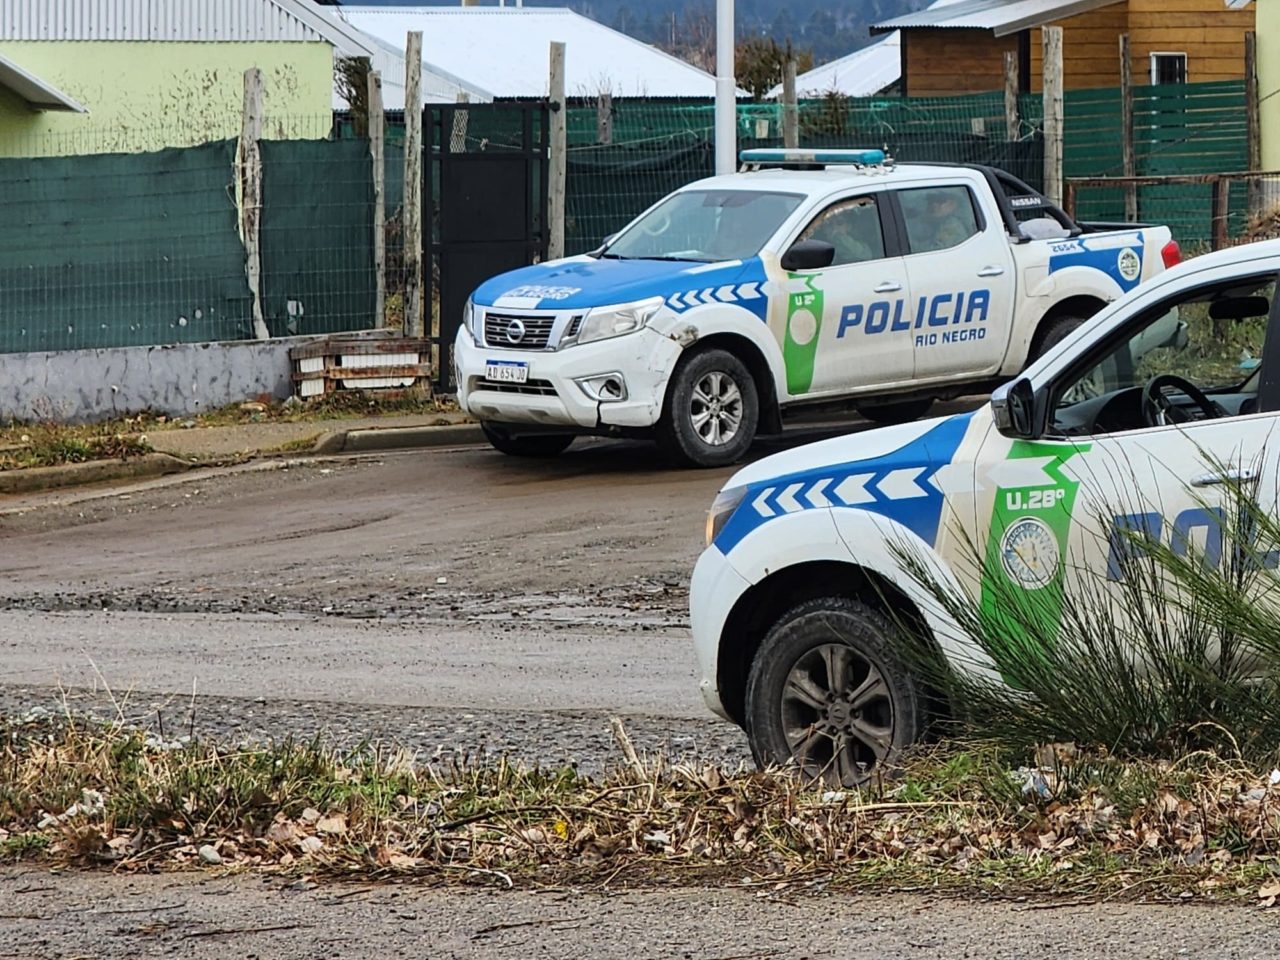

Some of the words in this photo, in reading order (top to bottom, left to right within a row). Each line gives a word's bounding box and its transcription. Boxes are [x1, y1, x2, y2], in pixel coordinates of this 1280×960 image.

[1011, 196, 1042, 207] NISSAN
[836, 289, 991, 339] POLICIA
[915, 333, 937, 347] RIO
[942, 327, 986, 344] NEGRO
